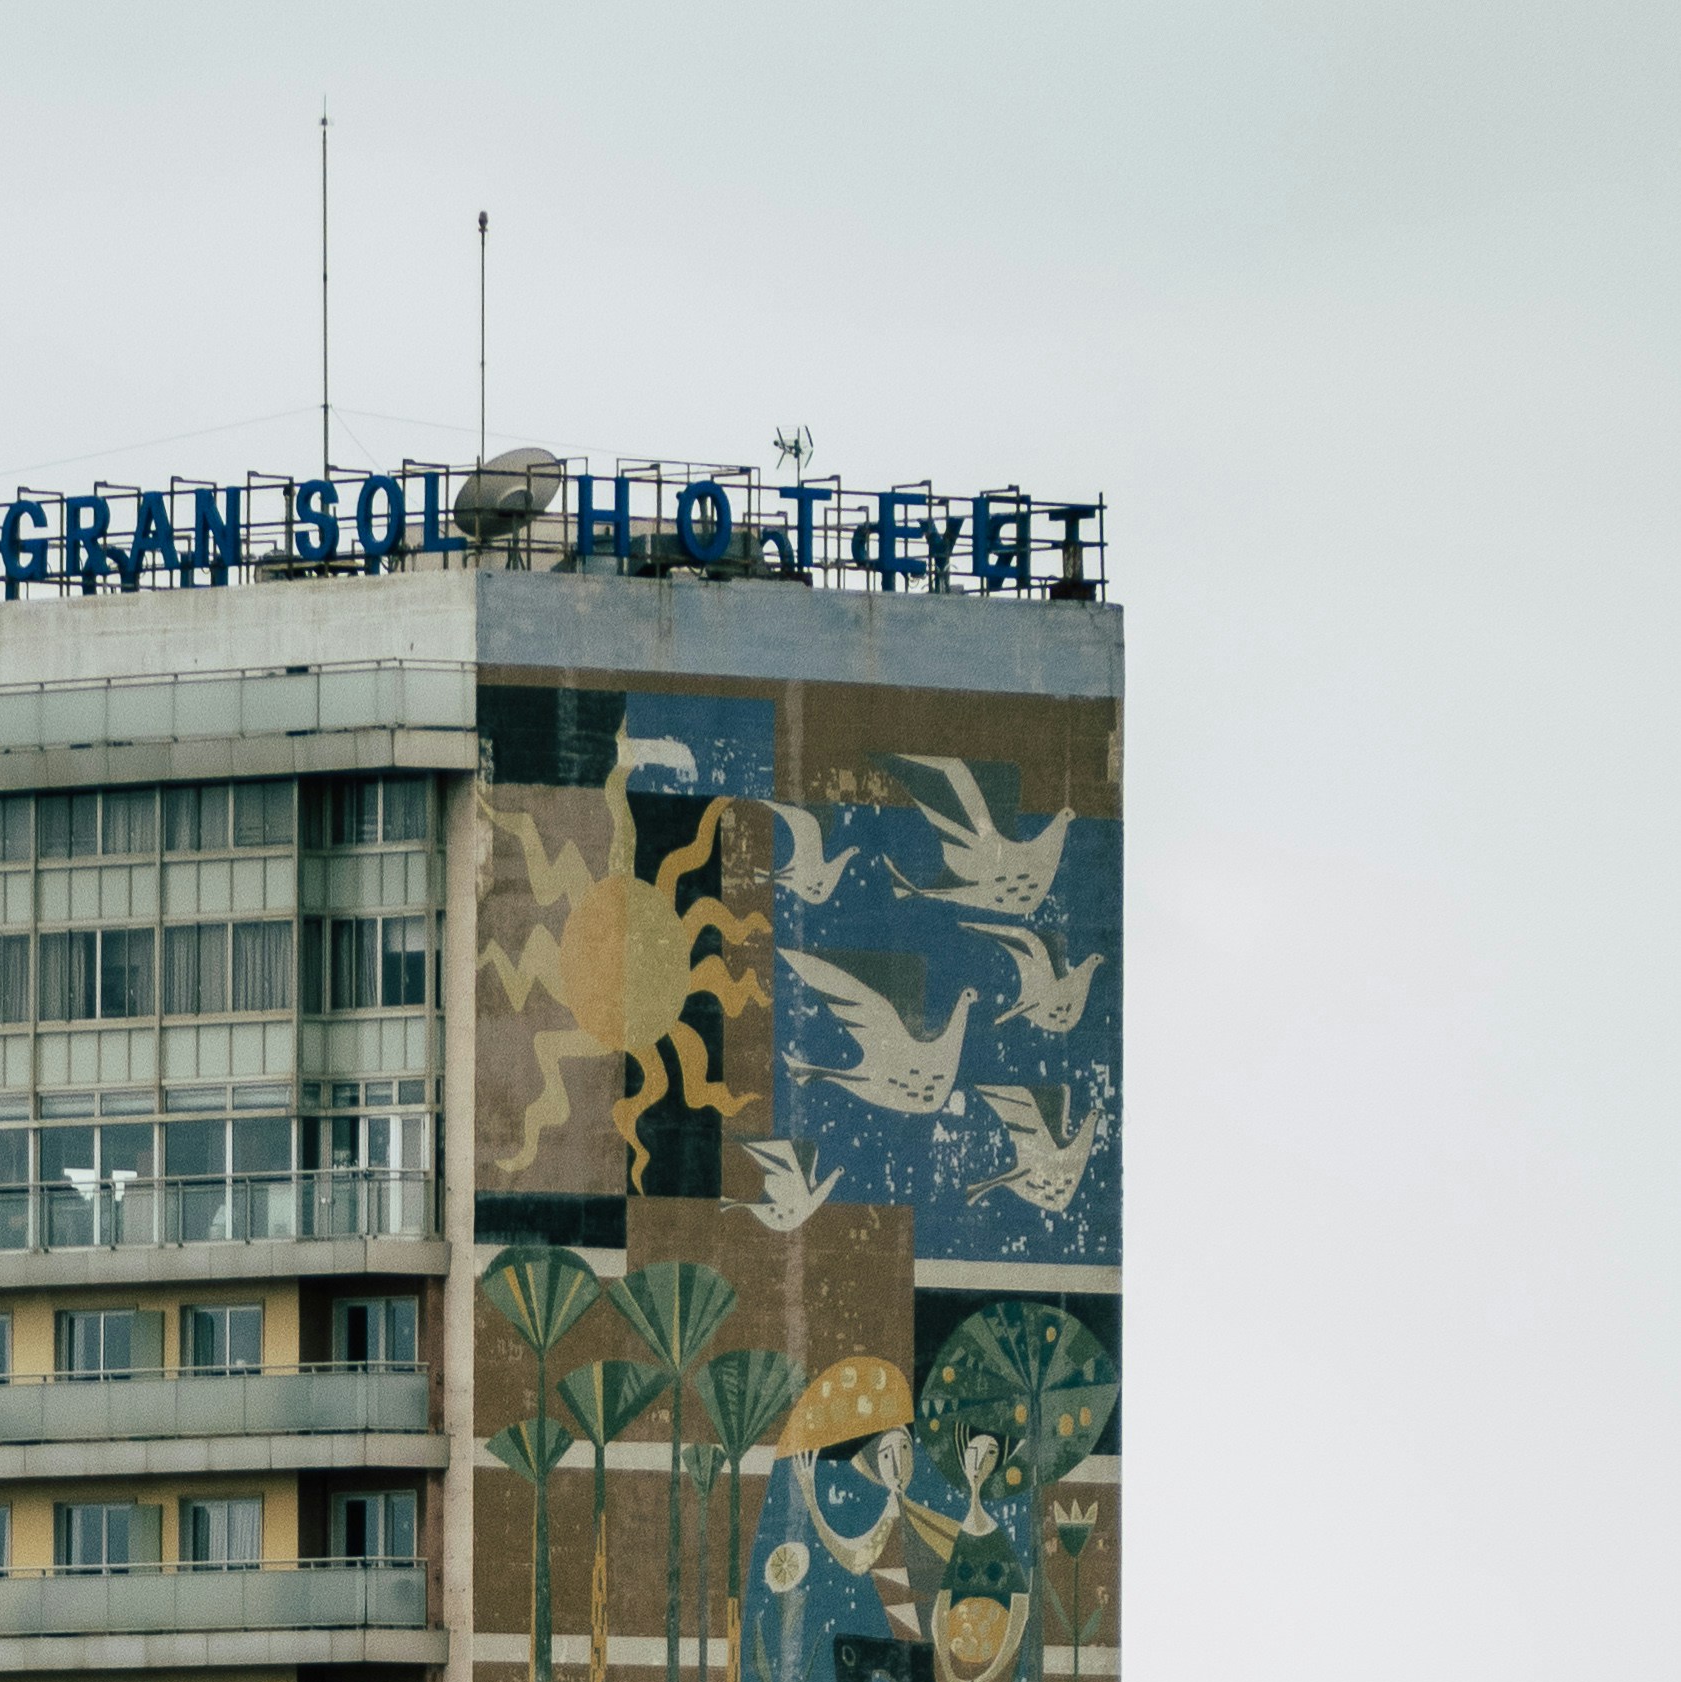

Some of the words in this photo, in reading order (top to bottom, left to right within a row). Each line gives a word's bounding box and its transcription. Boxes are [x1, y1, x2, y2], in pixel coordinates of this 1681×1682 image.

[1, 486, 242, 581] GRAN
[295, 471, 468, 561] SOL
[577, 474, 1019, 578] HOTEL
